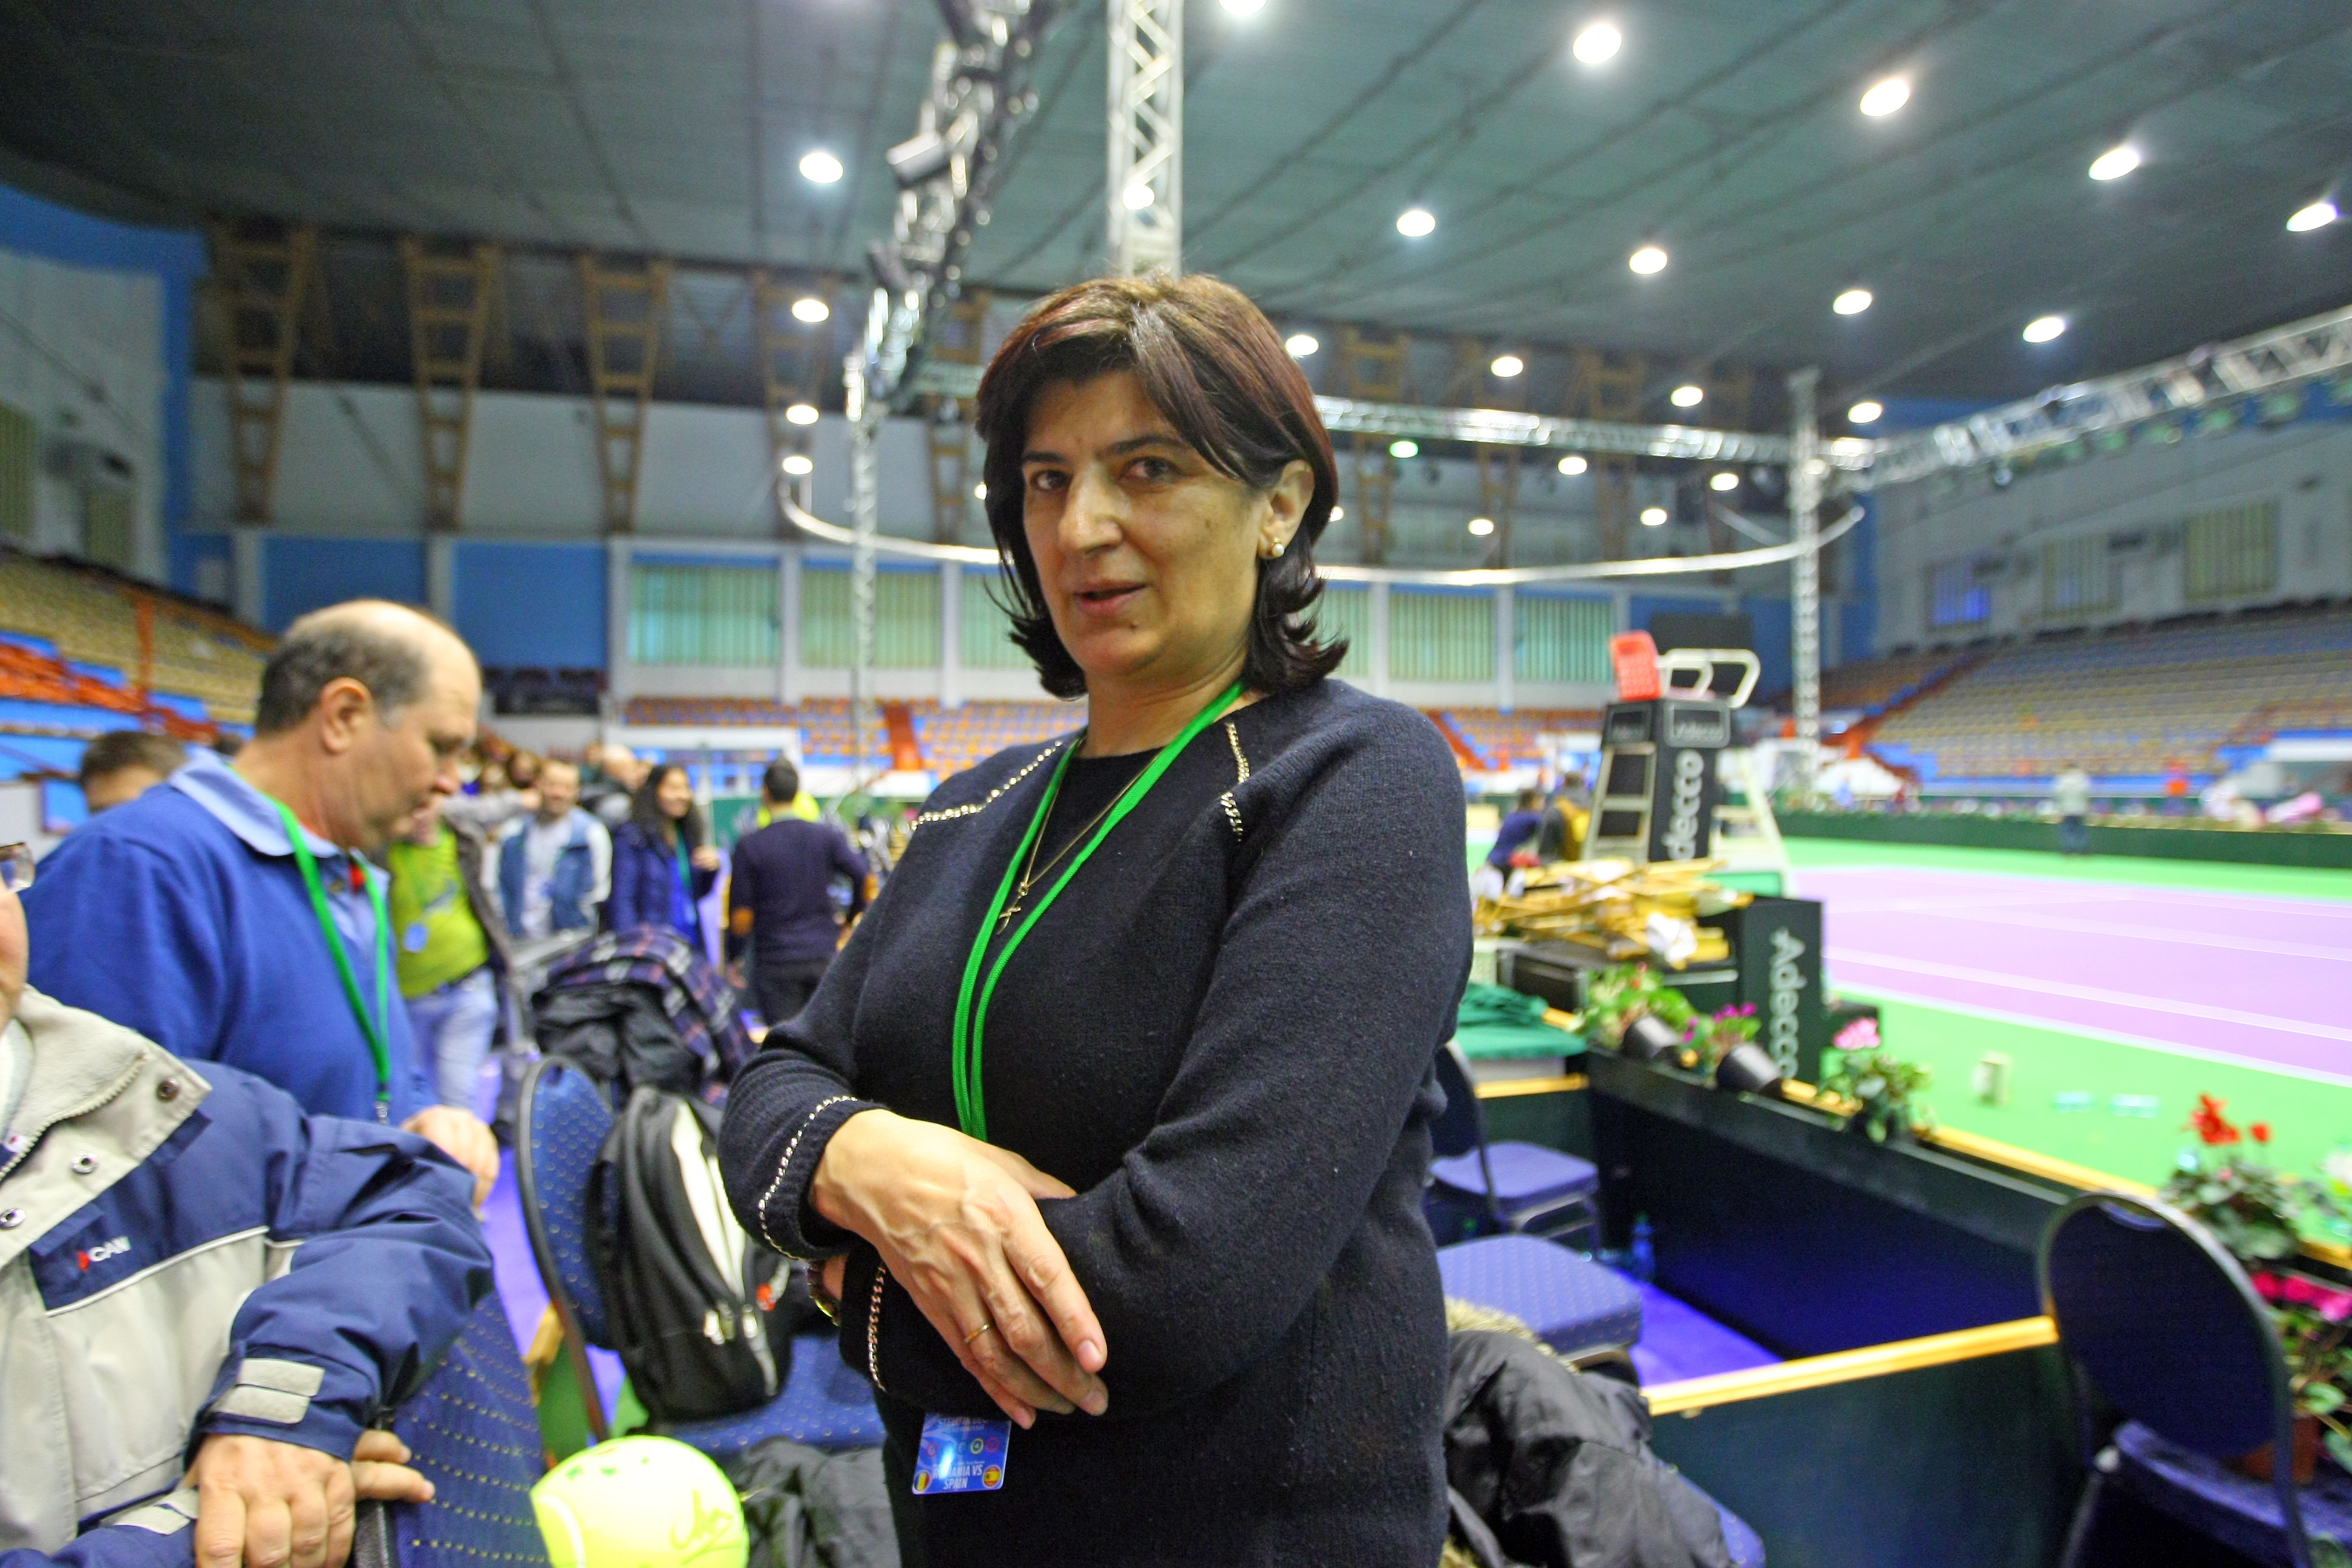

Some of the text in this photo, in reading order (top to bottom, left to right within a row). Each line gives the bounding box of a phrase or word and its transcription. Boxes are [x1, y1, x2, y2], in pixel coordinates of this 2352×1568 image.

[1661, 750, 1704, 860] decco
[1769, 927, 1808, 1079] Adecco
[972, 1464, 983, 1475] VS
